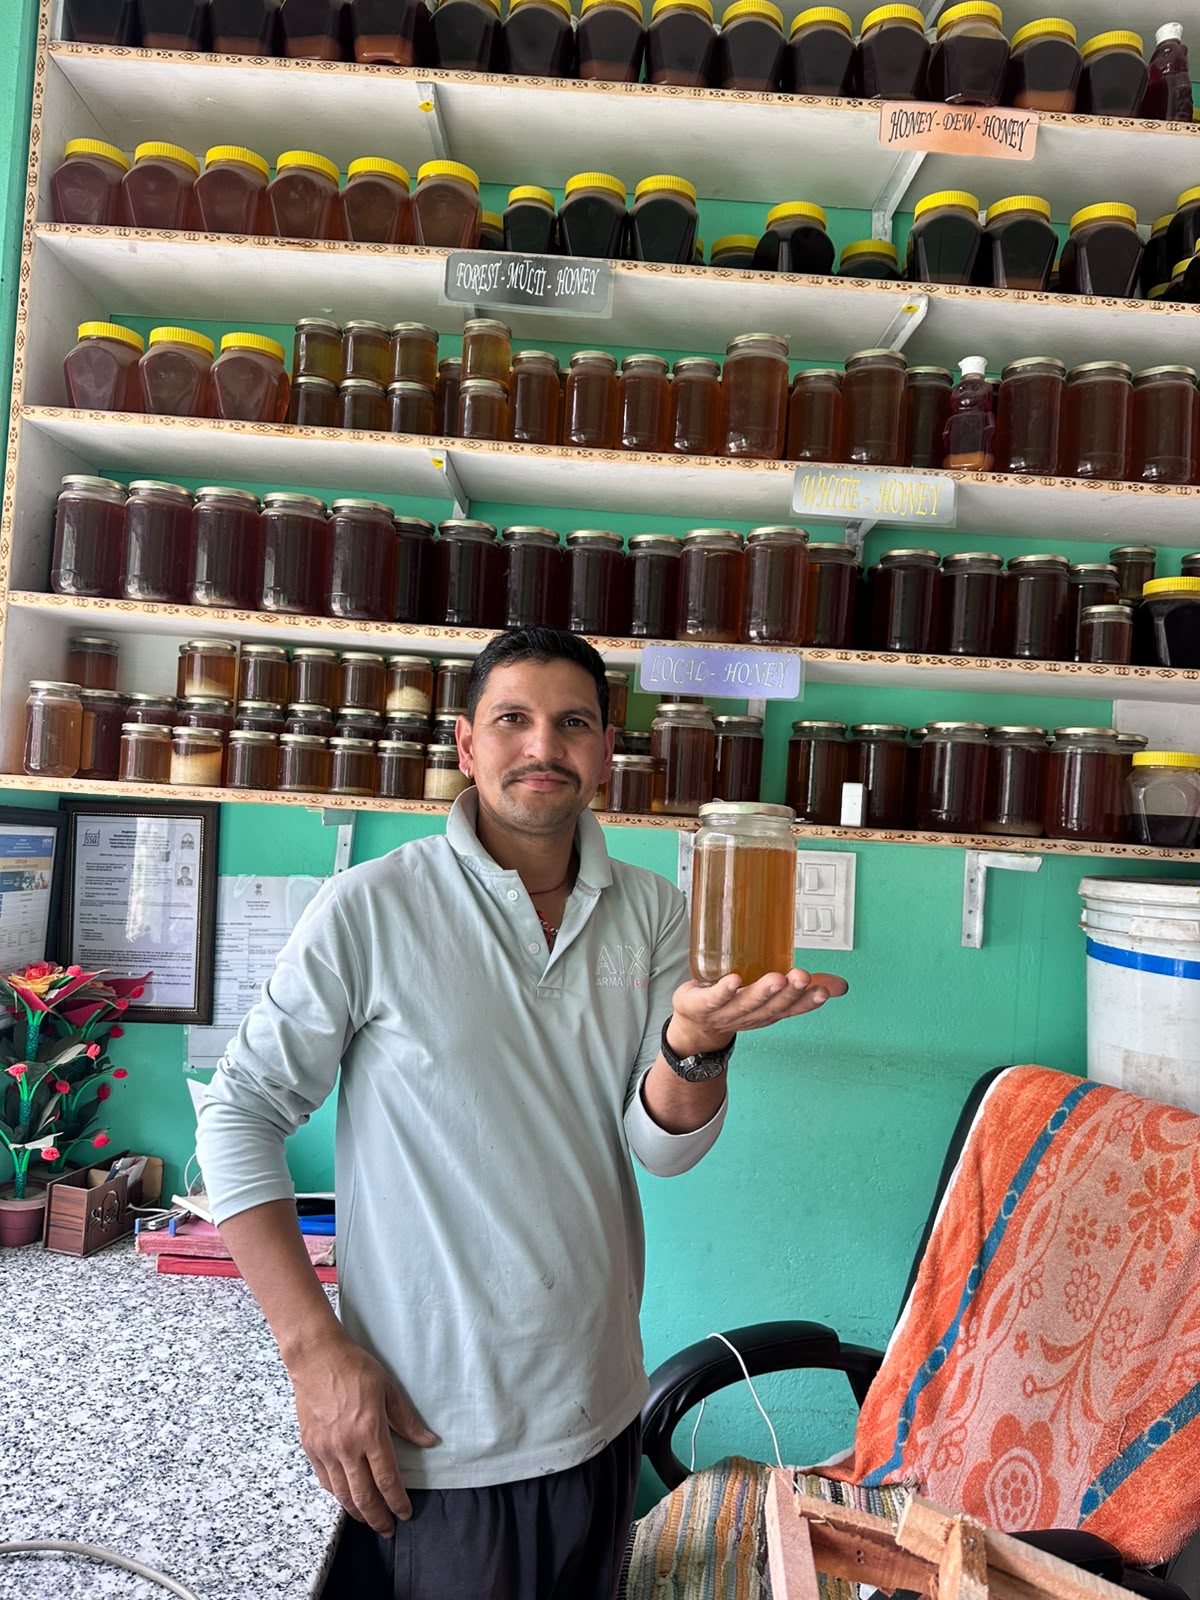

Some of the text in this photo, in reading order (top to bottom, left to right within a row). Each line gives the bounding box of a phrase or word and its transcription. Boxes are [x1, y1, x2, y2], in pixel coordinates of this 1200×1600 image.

[888, 109, 937, 142] HONEY
[943, 112, 976, 132] DEW
[982, 115, 1030, 152] HONEY
[456, 260, 502, 296] FOREST
[555, 266, 600, 296] HONEY
[802, 471, 862, 511] WHITE
[875, 479, 945, 516] HONEY
[650, 654, 706, 684] LOCAL
[723, 658, 791, 688] HONEY
